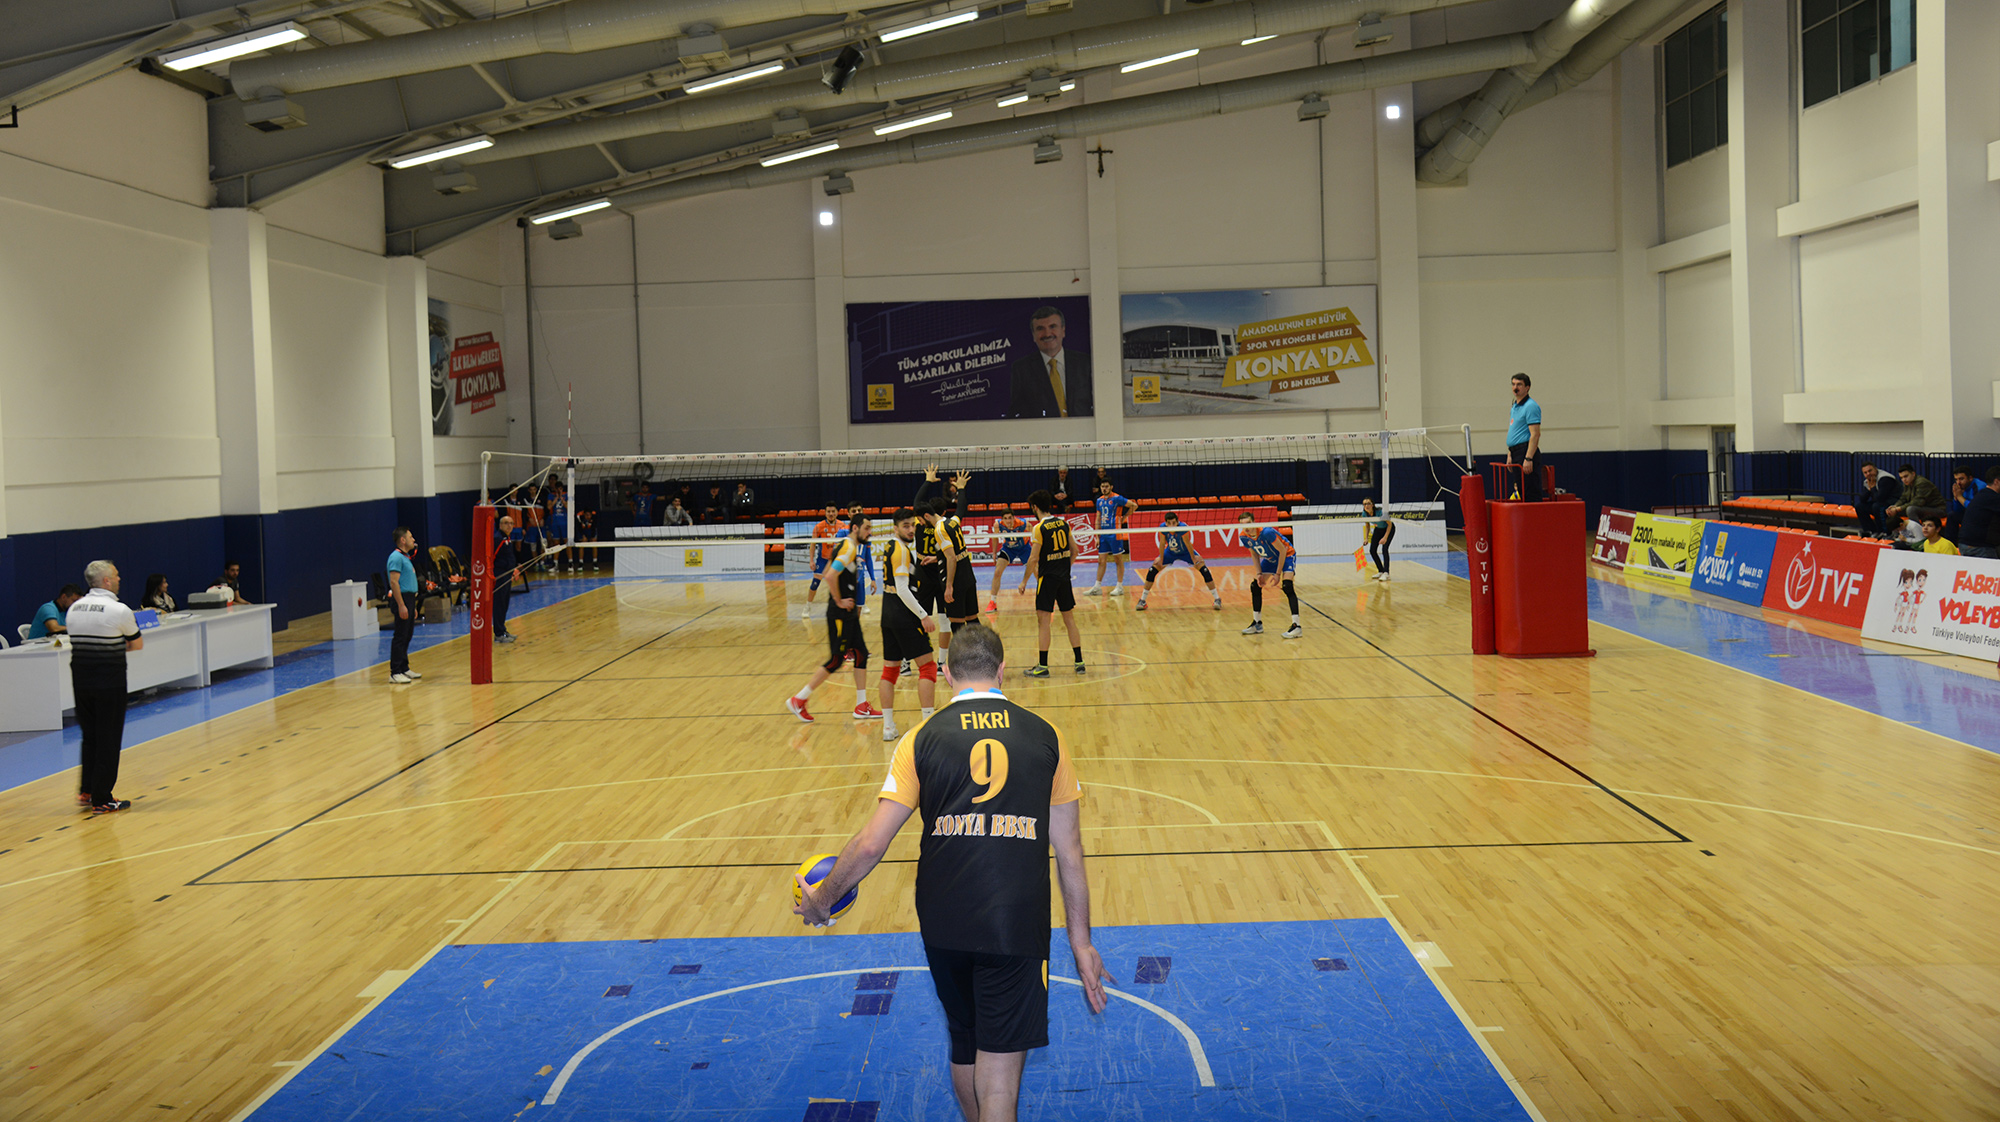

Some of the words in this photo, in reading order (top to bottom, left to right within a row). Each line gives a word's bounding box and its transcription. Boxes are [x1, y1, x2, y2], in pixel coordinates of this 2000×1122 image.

[1305, 317, 1317, 327] EN
[1318, 312, 1347, 325] BÜYÜK
[1246, 341, 1268, 351] SPOR
[1270, 339, 1281, 347] VE
[1282, 333, 1317, 346] KONGRE
[897, 357, 919, 371] TÜM
[1234, 342, 1362, 382] KONYA'DA
[1278, 381, 1289, 390] 10
[1051, 529, 1068, 551] 10
[1634, 526, 1653, 544] 2300
[1480, 561, 1489, 595] TVF
[1818, 567, 1864, 607] TVF
[473, 578, 482, 611] TVF
[1932, 626, 1954, 640] Türkiye
[1955, 630, 1983, 645] Voleybol
[960, 709, 1011, 730] FİKRİ
[969, 738, 1009, 804] 9
[990, 814, 1038, 840] BBSK
